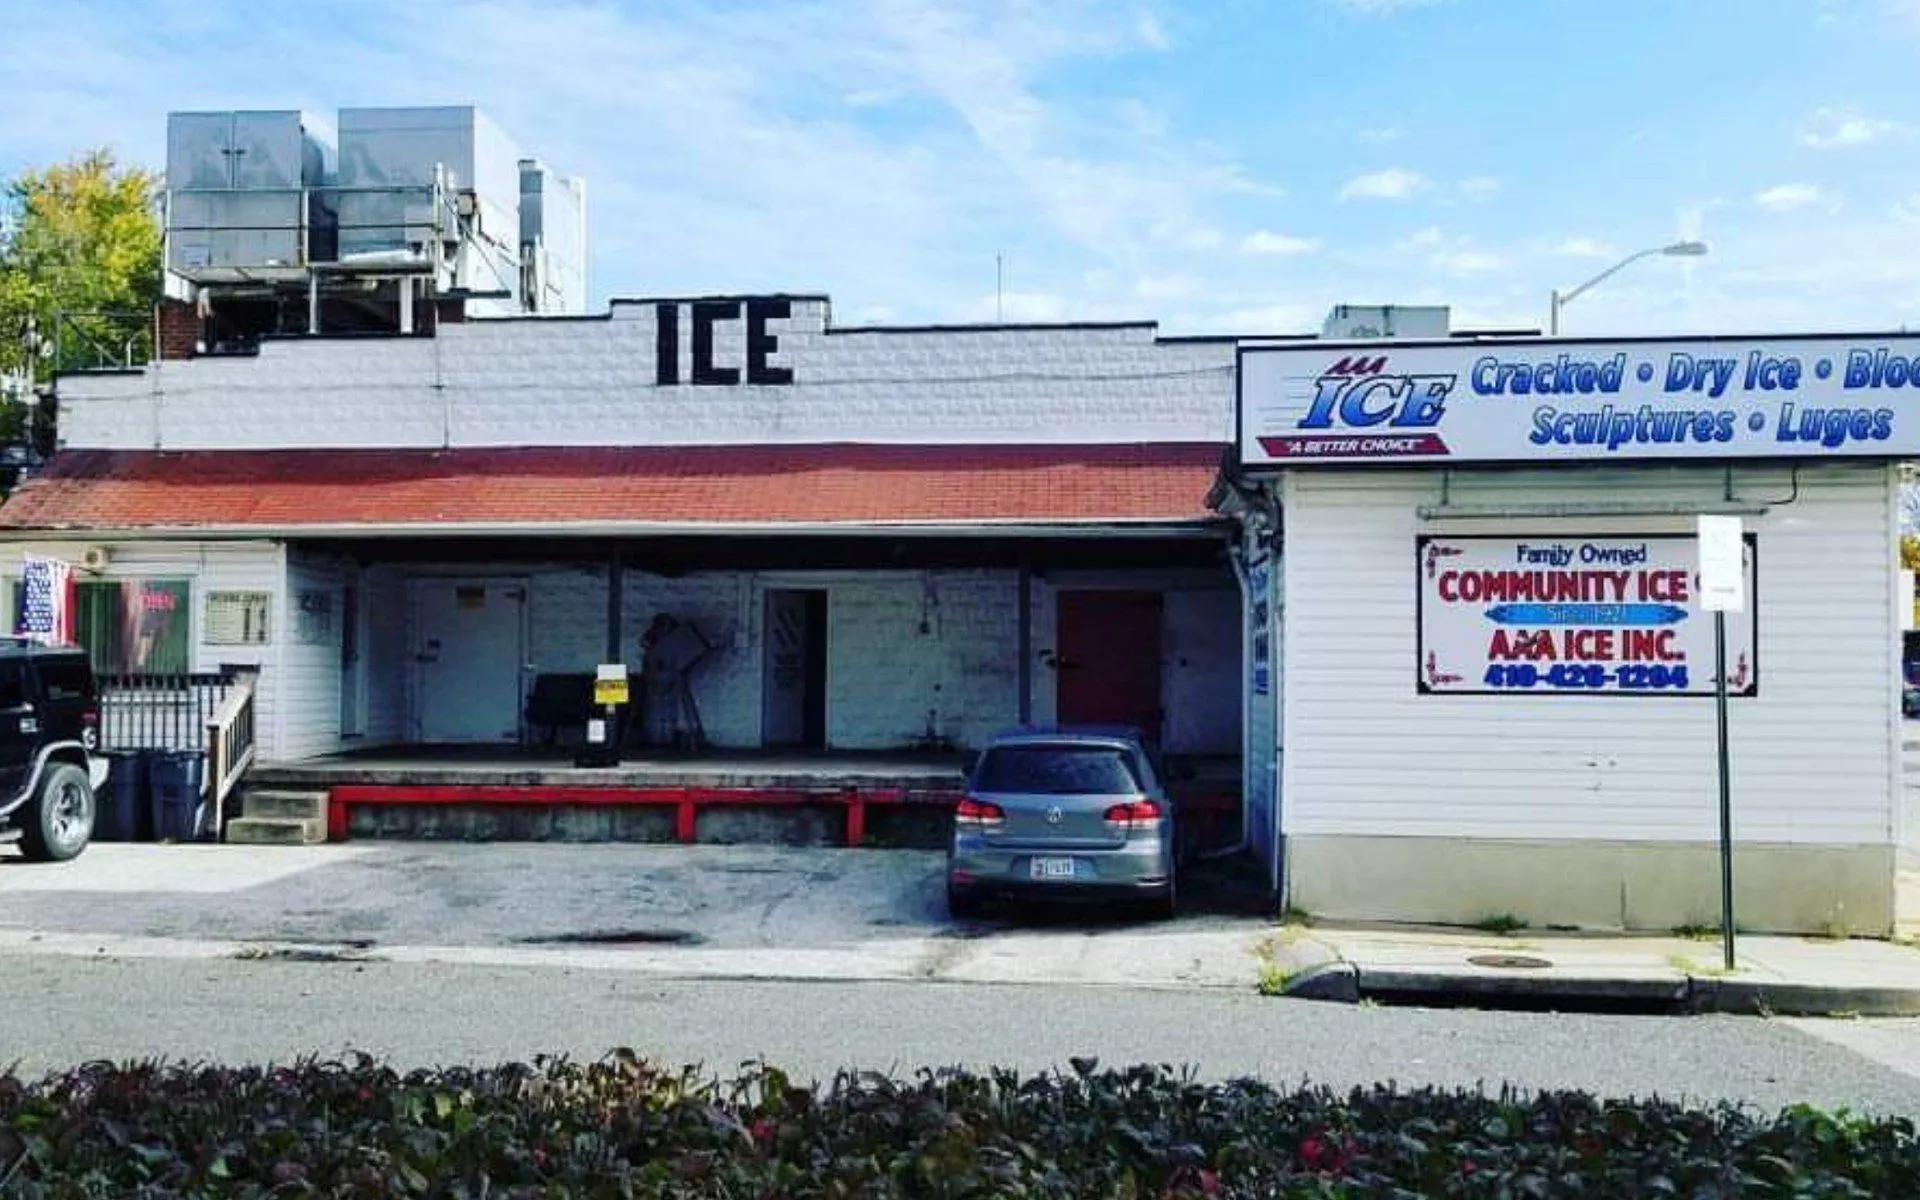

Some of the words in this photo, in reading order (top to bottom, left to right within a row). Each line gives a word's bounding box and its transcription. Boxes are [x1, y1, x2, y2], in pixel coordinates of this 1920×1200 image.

[657, 299, 794, 385] ICE
[1472, 353, 1626, 395] Cracked
[1664, 352, 1737, 397] Dry
[1744, 351, 1800, 390] Ice
[1297, 374, 1457, 429] ICE
[1529, 403, 1736, 450] Sculptures
[1776, 402, 1895, 447] Luges
[1304, 439, 1360, 453] BETTER
[1516, 544, 1574, 566] Family
[1580, 544, 1648, 563] Owned
[1439, 571, 1630, 602] COMMUNITY
[1638, 571, 1689, 602] ICE
[1488, 629, 1557, 661] AAA
[1564, 629, 1617, 661] ICE
[1622, 629, 1686, 661] INC.
